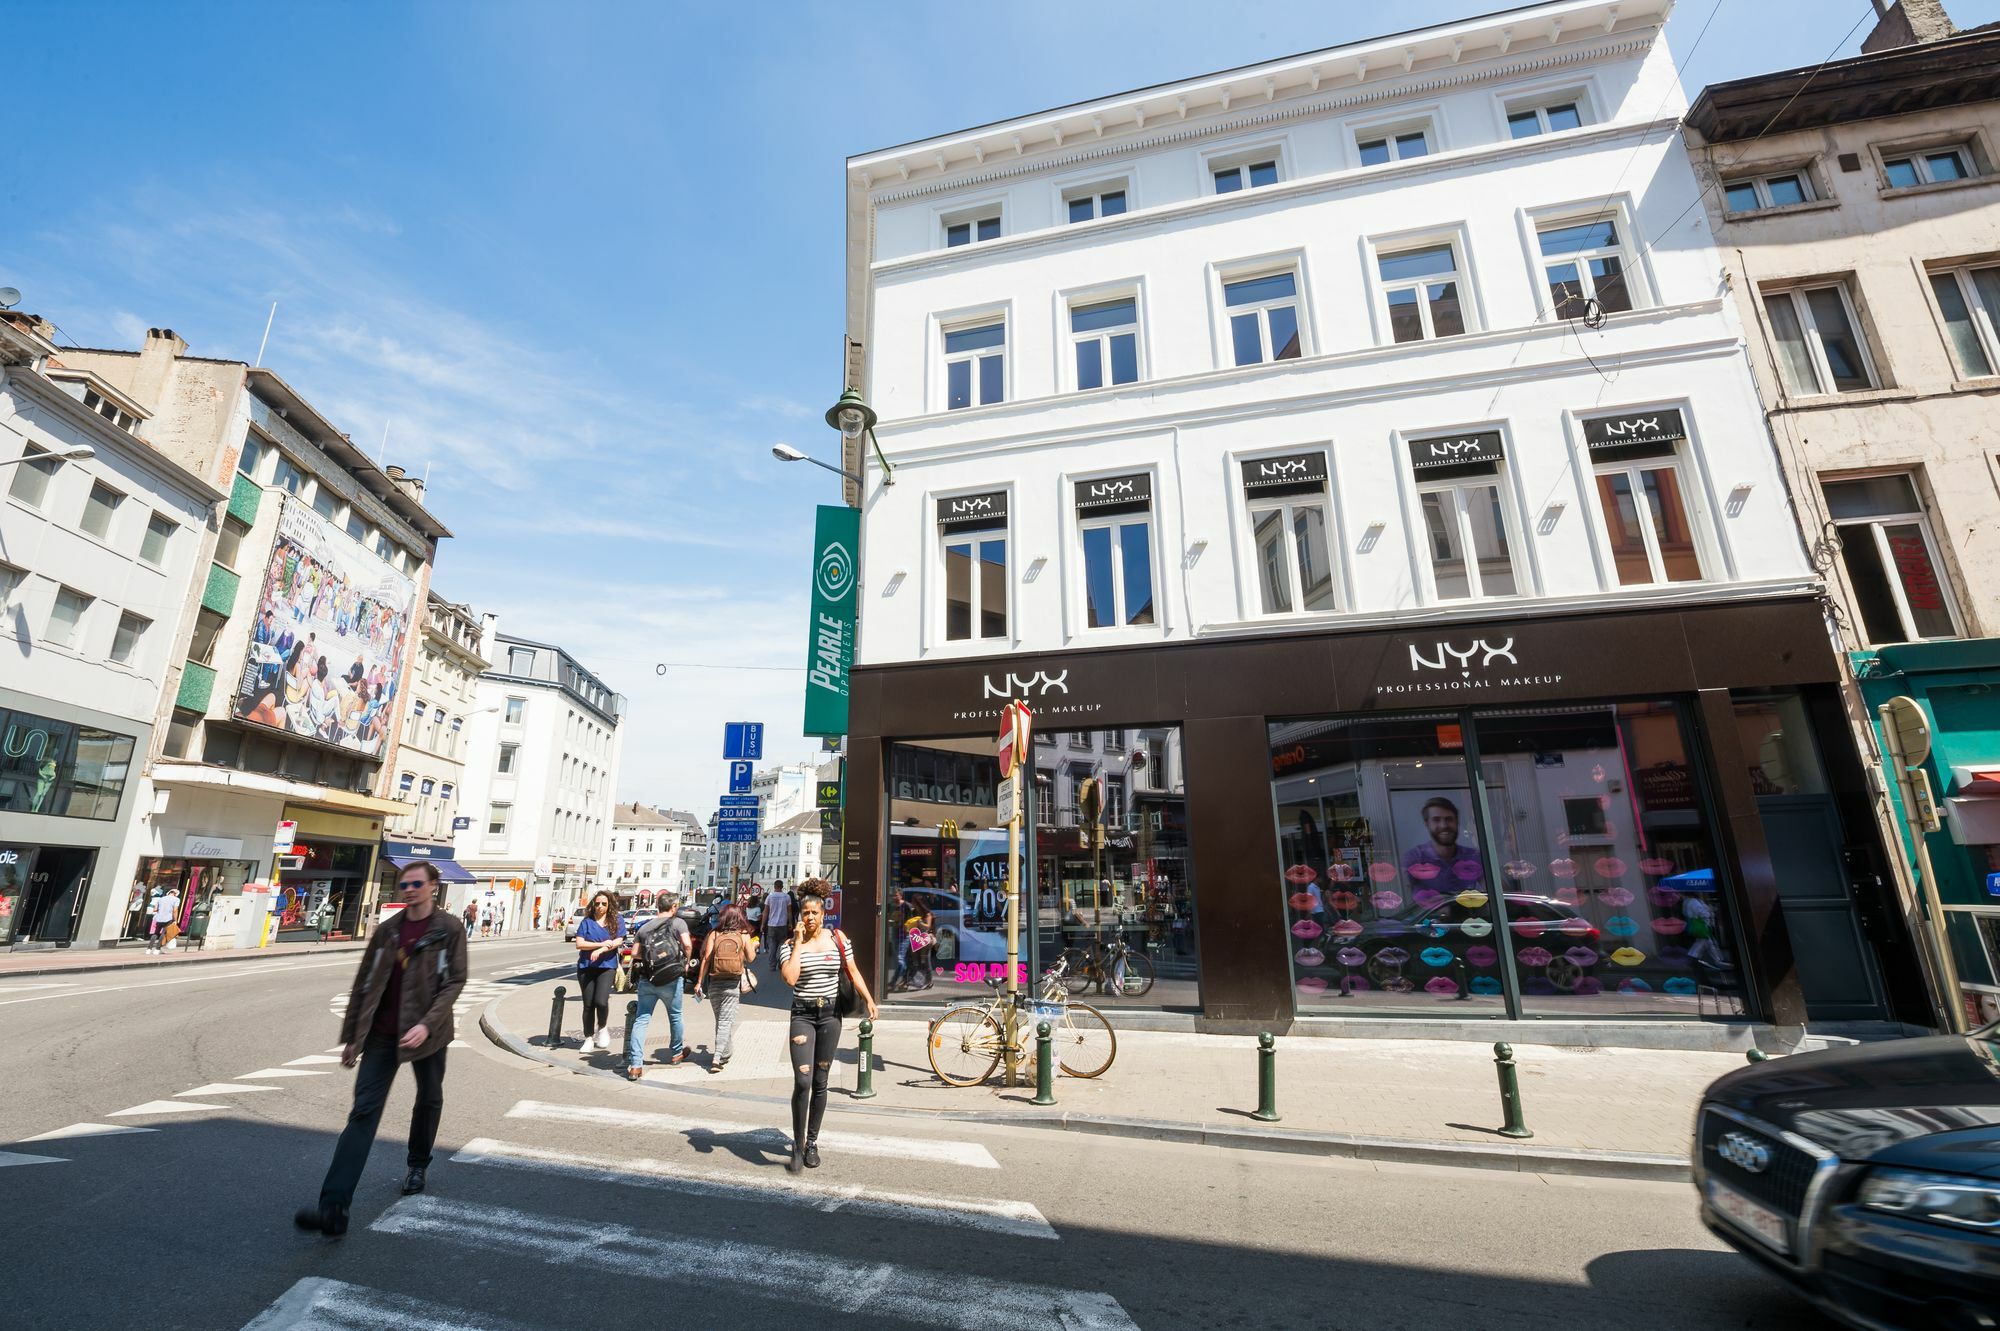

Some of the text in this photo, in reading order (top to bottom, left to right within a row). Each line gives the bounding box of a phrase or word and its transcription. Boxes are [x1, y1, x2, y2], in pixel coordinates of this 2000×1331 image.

[1605, 417, 1660, 436] NYX
[1430, 438, 1481, 457] NYX
[1590, 433, 1682, 447] PROFESSIONAL MAKEUP
[1260, 459, 1307, 477] NYX
[1415, 454, 1501, 467] PROFESSIONAL MAKEUP
[1091, 480, 1133, 498] NYX
[1246, 474, 1325, 487] PROFESSIONAL MAKEUP
[952, 497, 991, 513] NYX
[1077, 494, 1149, 507] PROFESSIONAL MAKEUP
[939, 511, 1007, 523] PROFESSIONAL MAKEUP
[809, 611, 843, 694] PEARLE
[840, 621, 852, 697] OPTICIENS
[1409, 637, 1518, 671] NYX
[984, 669, 1068, 699] NYX
[1377, 675, 1563, 694] PROFESSIONAL MAKEUP
[953, 703, 1102, 719] PROFESSAL MAKEUP
[735, 763, 748, 781] P
[722, 809, 734, 817] 30
[191, 841, 221, 856] Etam
